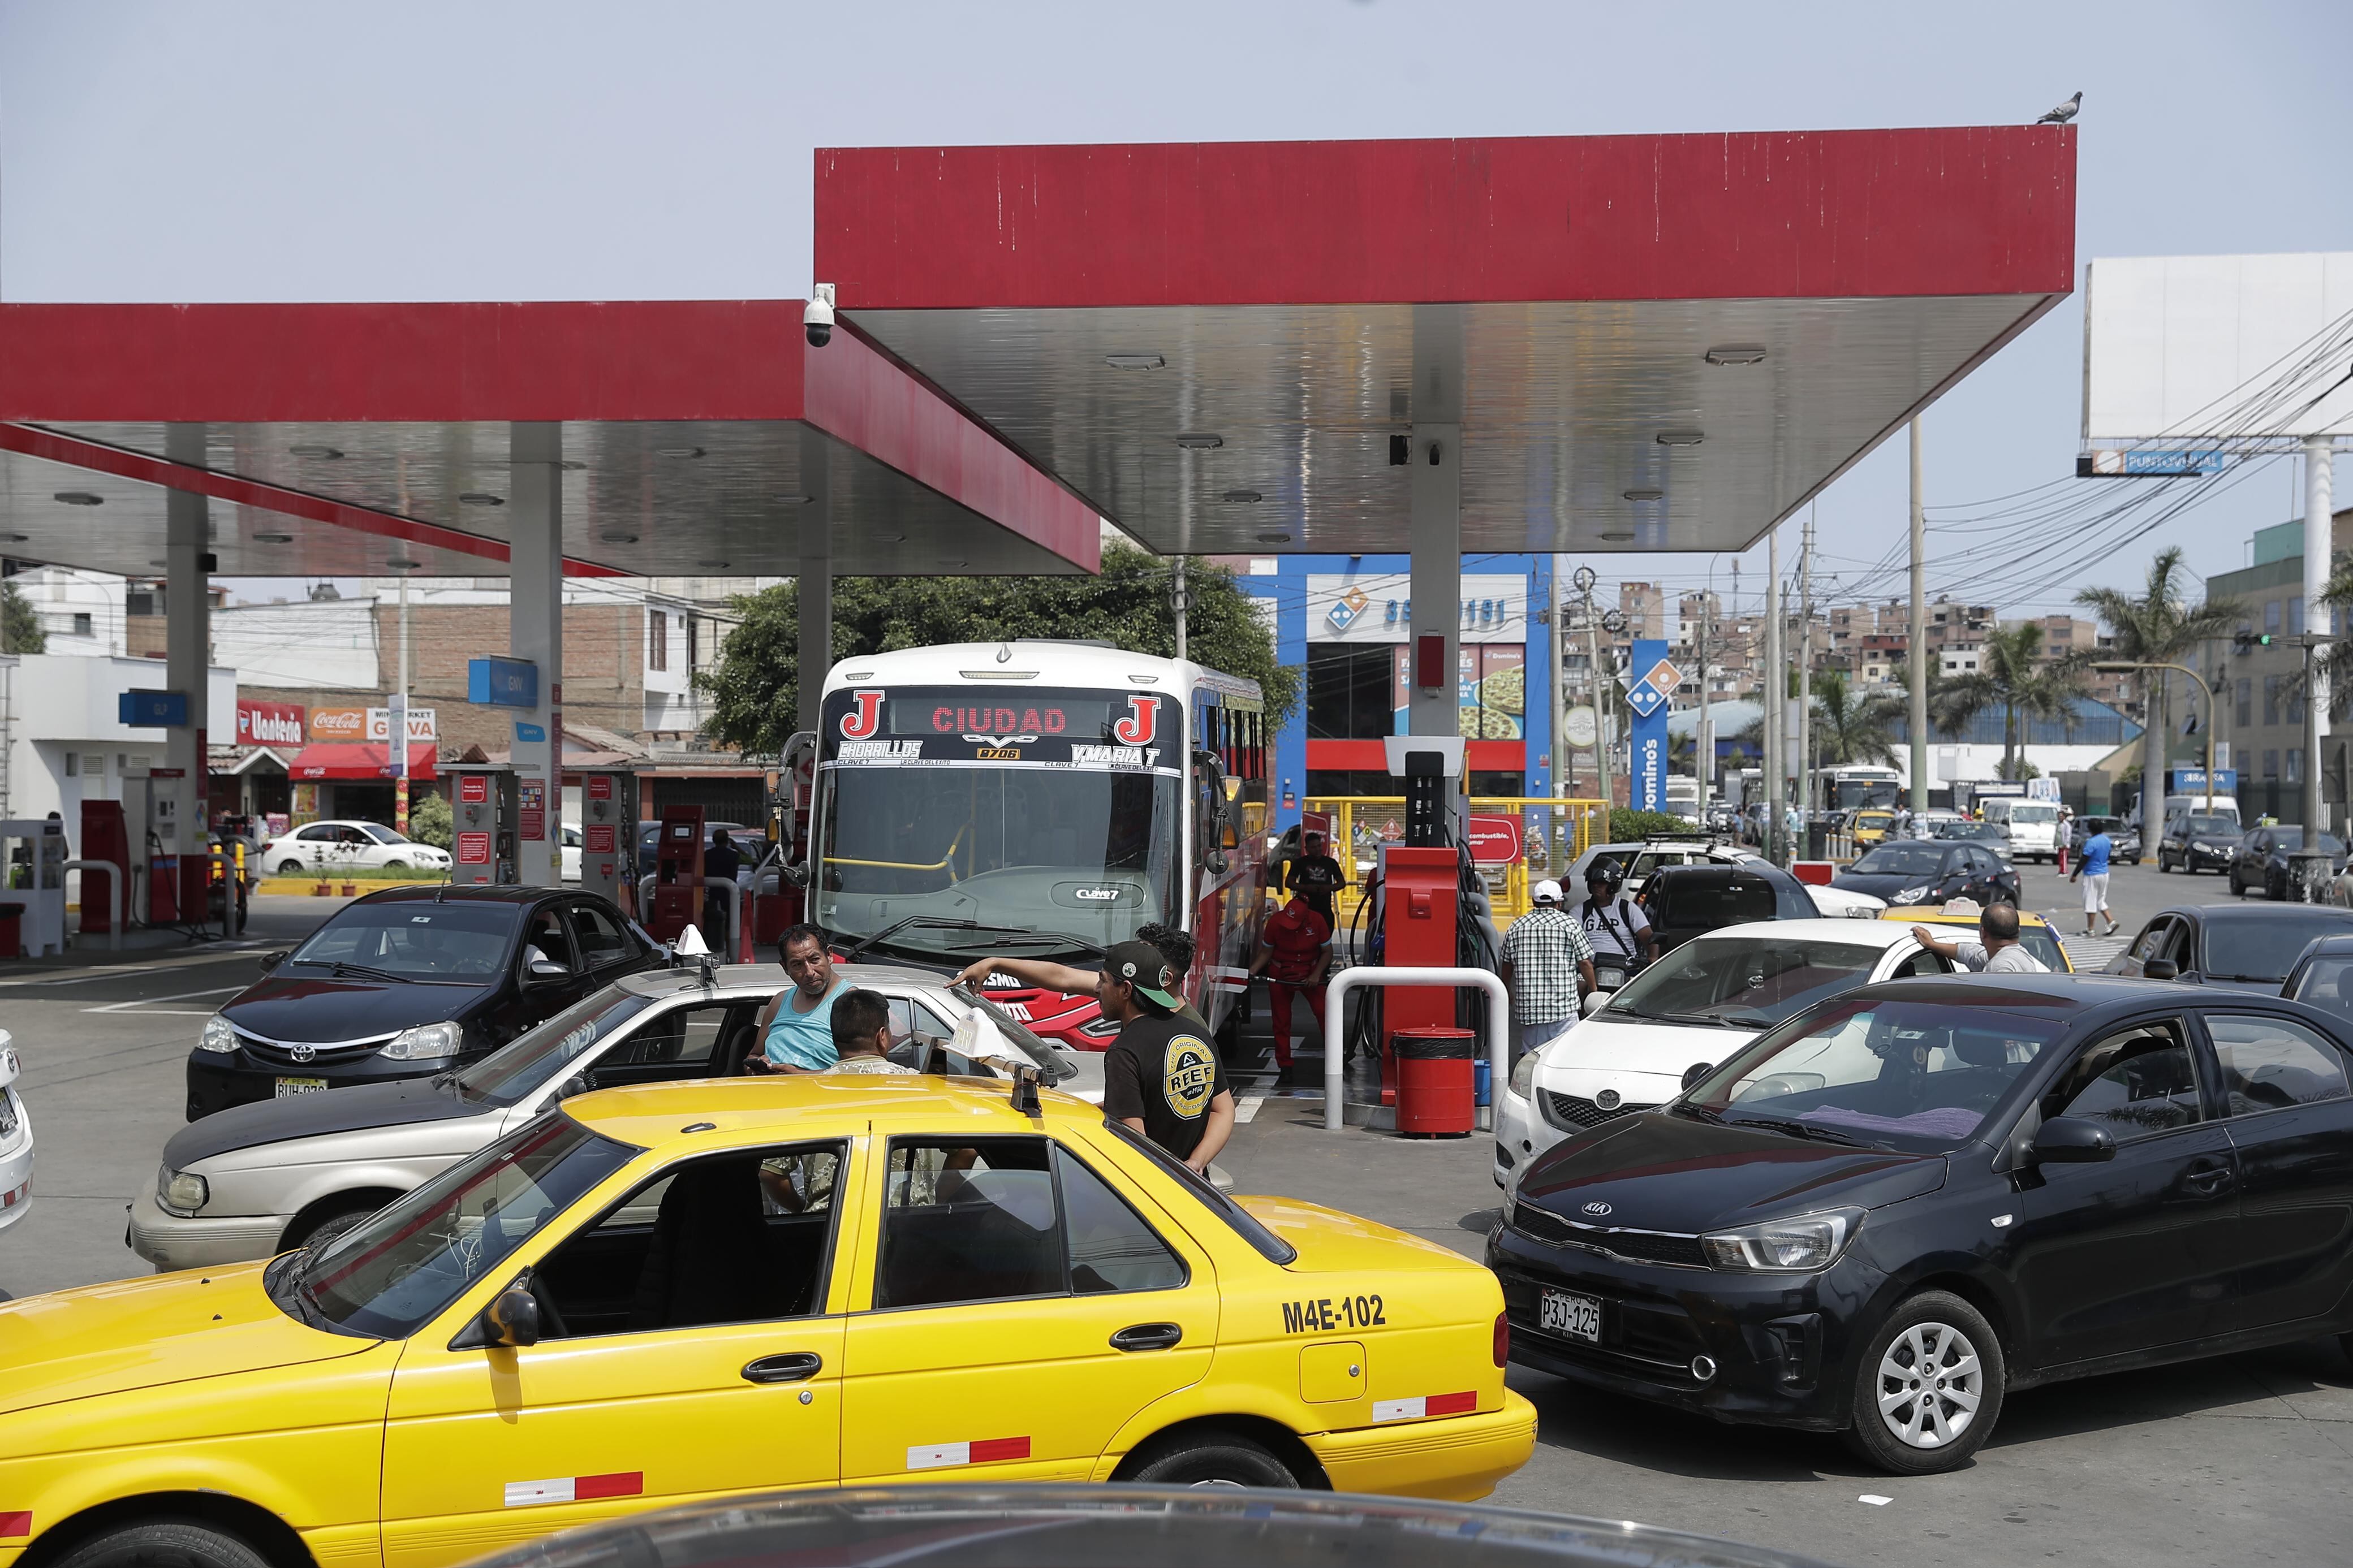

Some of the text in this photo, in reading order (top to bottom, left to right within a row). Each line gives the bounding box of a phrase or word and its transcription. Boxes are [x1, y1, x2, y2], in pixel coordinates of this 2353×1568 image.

[840, 690, 885, 740] J
[933, 707, 1066, 733] CIUDAD
[1114, 695, 1162, 746] J
[837, 740, 924, 759] CHORRILLOS
[979, 749, 1018, 758] 8706
[1585, 918, 1619, 932] GAP
[1175, 1042, 1209, 1060] ORIGINAL
[1170, 1066, 1212, 1091] REEF
[1584, 1202, 1606, 1214] KIA
[1559, 1293, 1581, 1305] PERU
[1282, 1294, 1386, 1334] M4E-102
[1543, 1297, 1599, 1335] P3J-125
